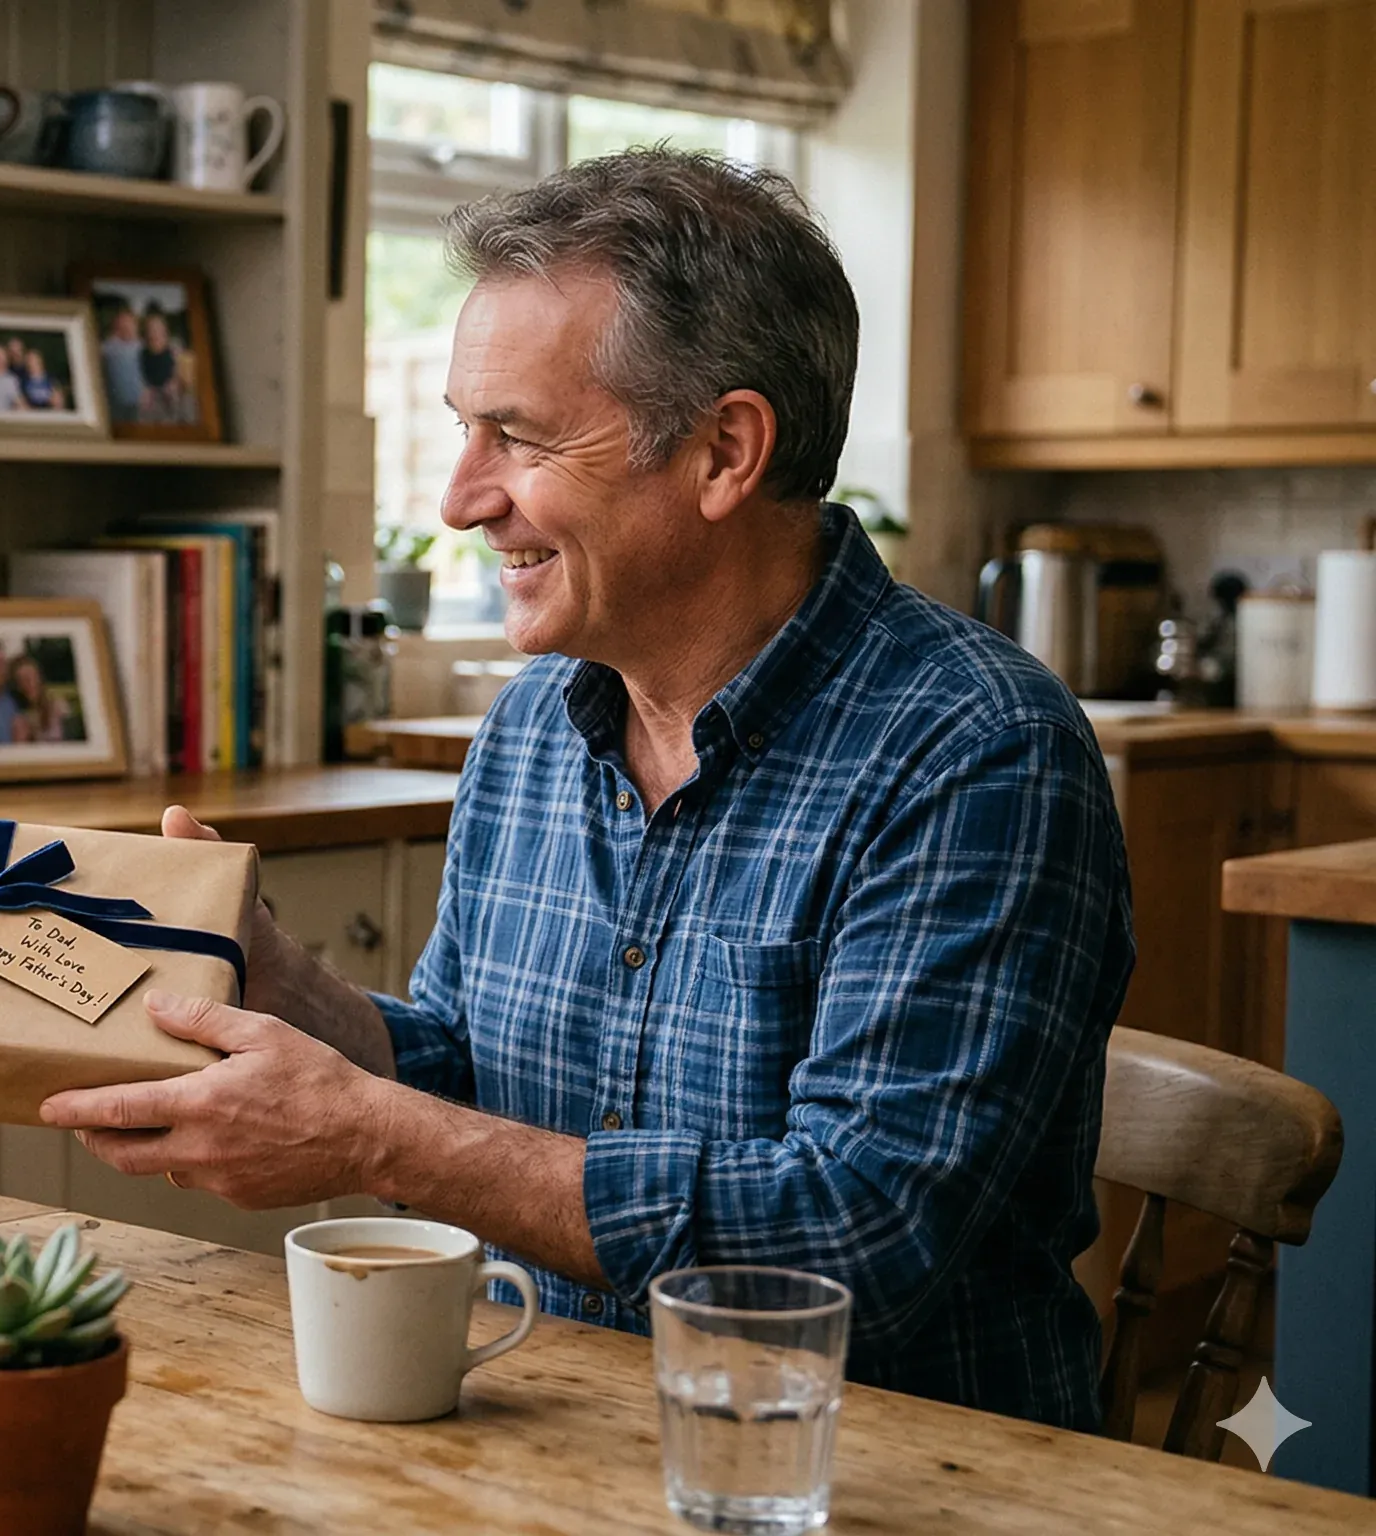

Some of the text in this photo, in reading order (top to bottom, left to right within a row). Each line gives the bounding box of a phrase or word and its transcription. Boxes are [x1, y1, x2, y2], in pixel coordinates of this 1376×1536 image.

[29, 917, 77, 950] To Dad,
[21, 935, 85, 974] With Love
[19, 956, 68, 987] Father's
